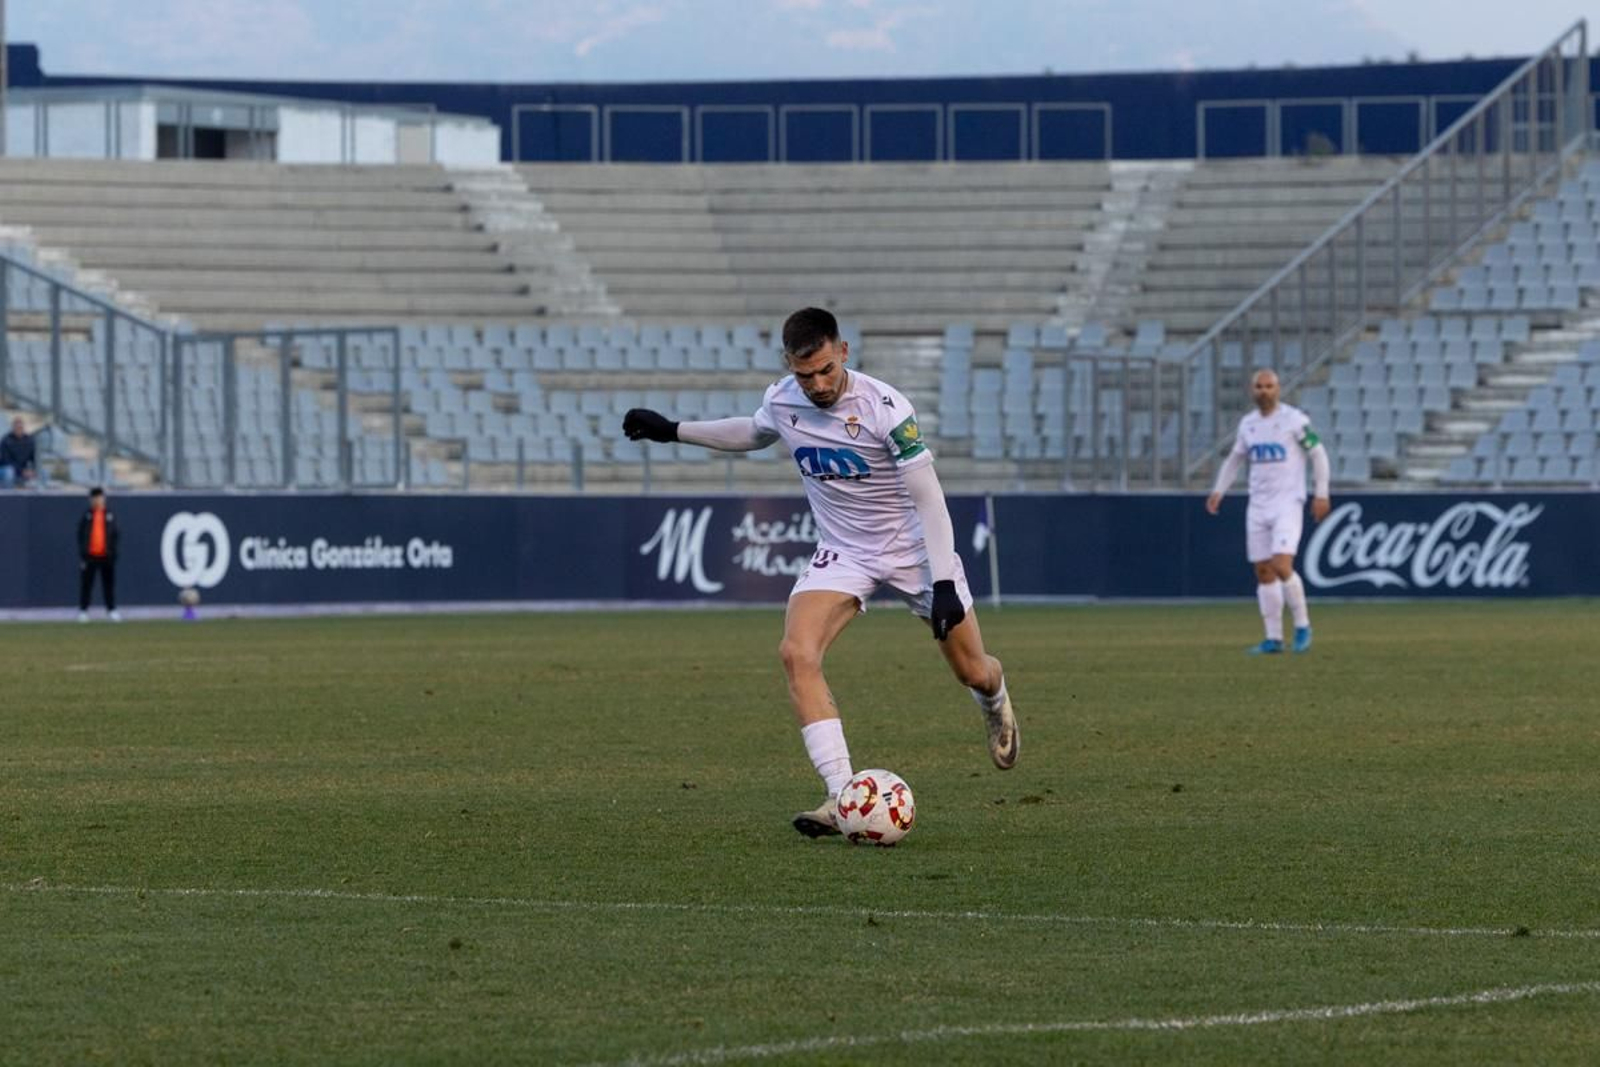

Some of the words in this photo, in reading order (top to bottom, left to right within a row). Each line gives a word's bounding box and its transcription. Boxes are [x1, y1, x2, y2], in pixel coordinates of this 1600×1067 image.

[310, 536, 403, 569] González
[406, 537, 452, 568] Orta
[639, 506, 723, 593] M
[1304, 502, 1544, 588] Coca-Cola
